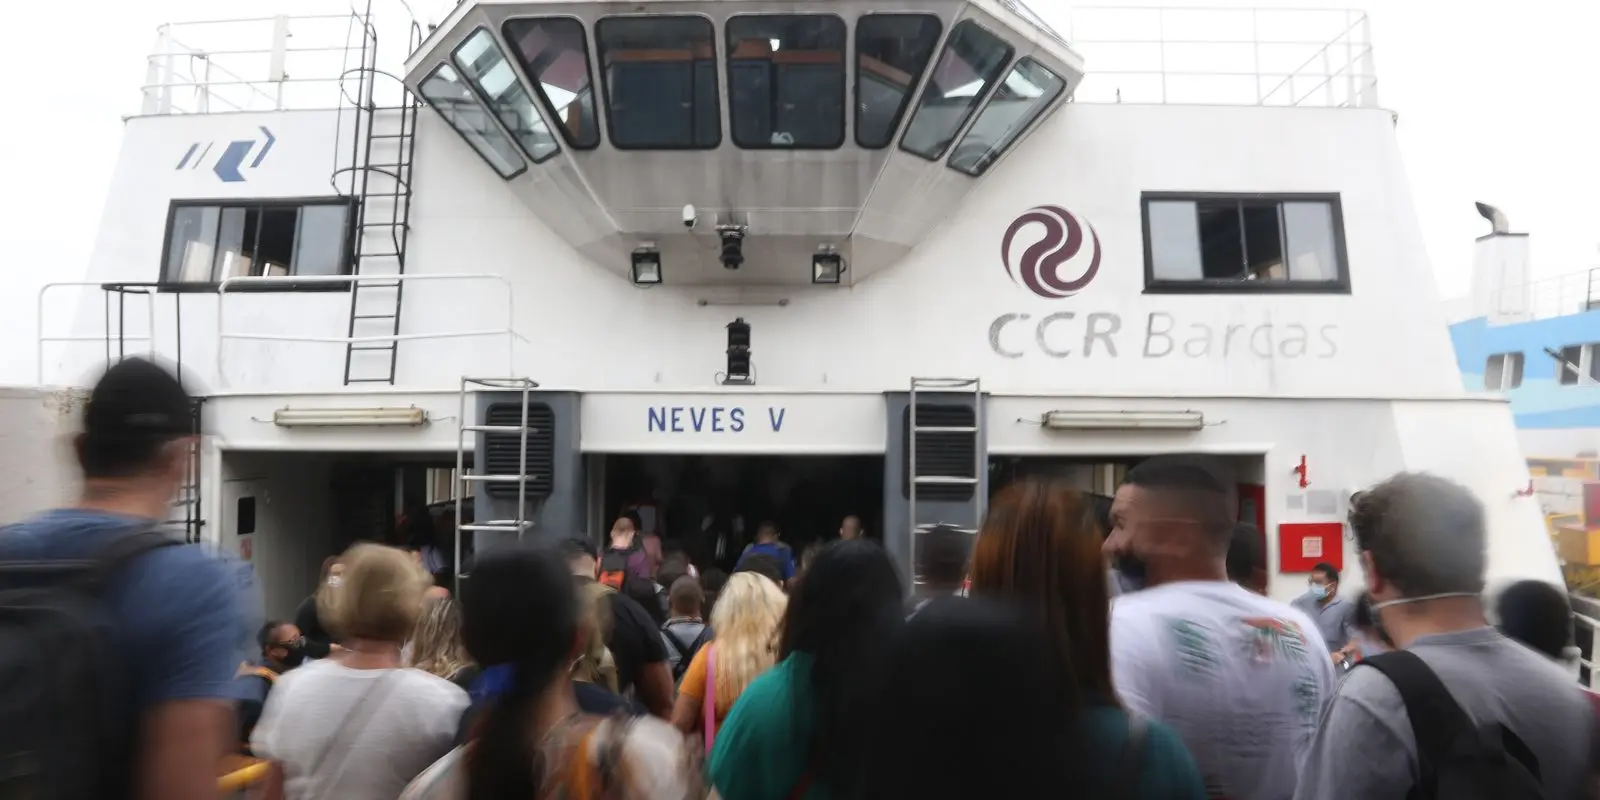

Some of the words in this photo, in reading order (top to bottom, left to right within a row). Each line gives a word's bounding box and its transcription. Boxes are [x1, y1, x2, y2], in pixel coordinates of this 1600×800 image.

[988, 311, 1122, 359] CCR
[1142, 311, 1339, 359] Barcas
[648, 406, 745, 433] NEVES
[768, 406, 786, 433] V
